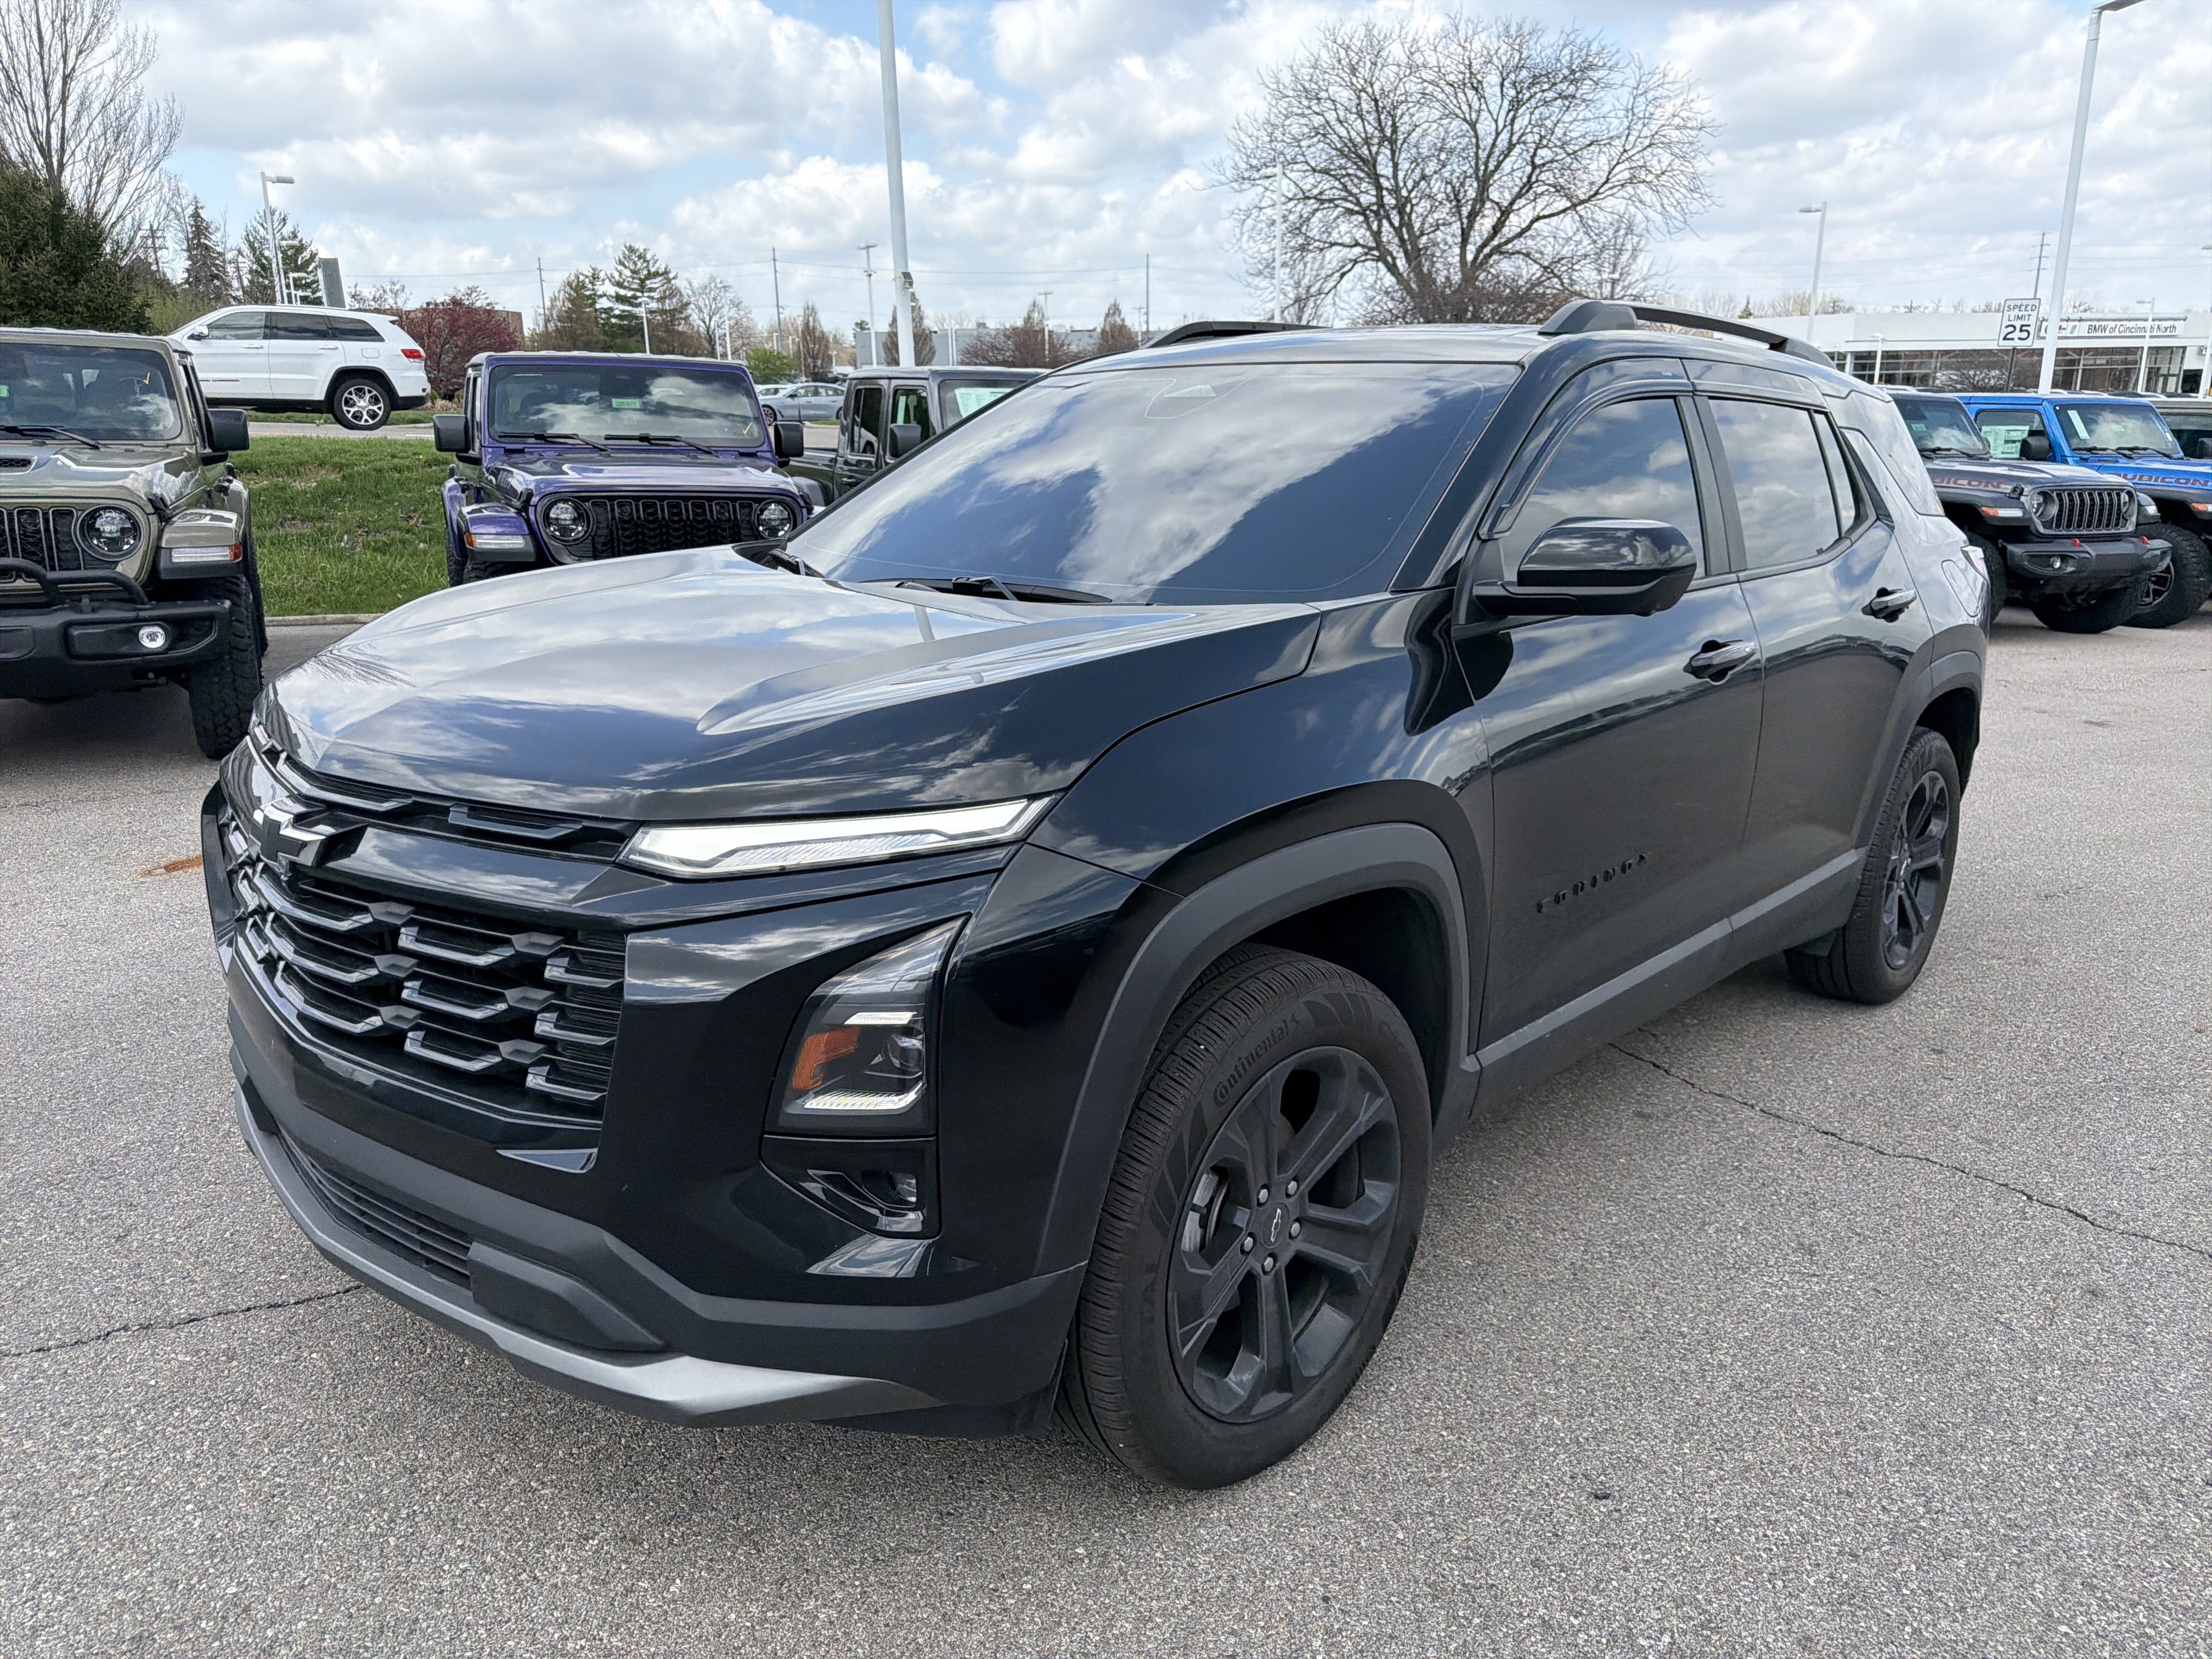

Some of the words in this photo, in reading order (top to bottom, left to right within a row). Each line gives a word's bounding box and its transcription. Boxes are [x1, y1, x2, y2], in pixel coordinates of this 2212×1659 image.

[2006, 304, 2037, 312] SPEED
[2007, 314, 2032, 322] LIMIT
[2002, 324, 2032, 341] 25
[2087, 324, 2108, 334] BMW
[2109, 324, 2118, 334] of
[2118, 323, 2155, 334] Cincinnti
[2156, 323, 2177, 334] North
[2106, 472, 2210, 487] UBICON
[1212, 1017, 1290, 1108] Continental
